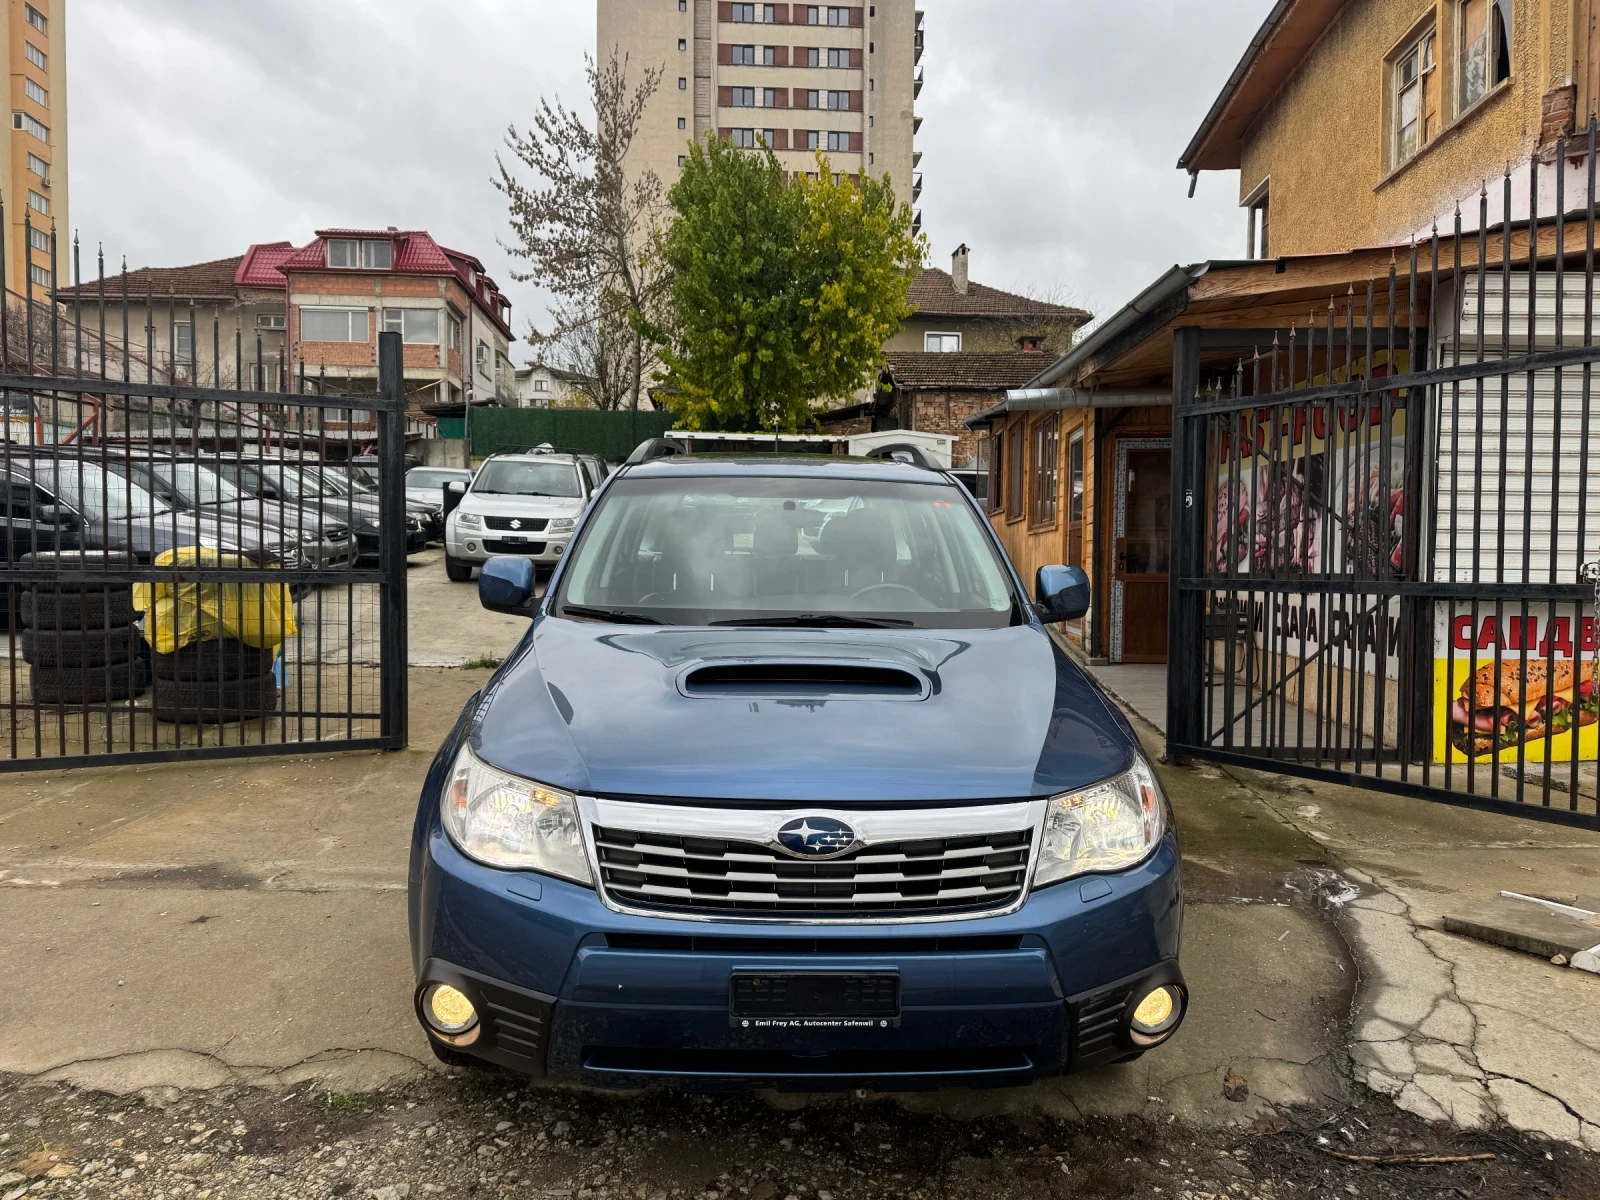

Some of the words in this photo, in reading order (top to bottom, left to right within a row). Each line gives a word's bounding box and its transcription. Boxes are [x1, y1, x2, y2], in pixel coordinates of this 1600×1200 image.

[1274, 603, 1318, 643] САА
[1332, 609, 1401, 658] СААИ
[772, 1020, 788, 1028] Frey
[789, 1020, 802, 1028] AG,
